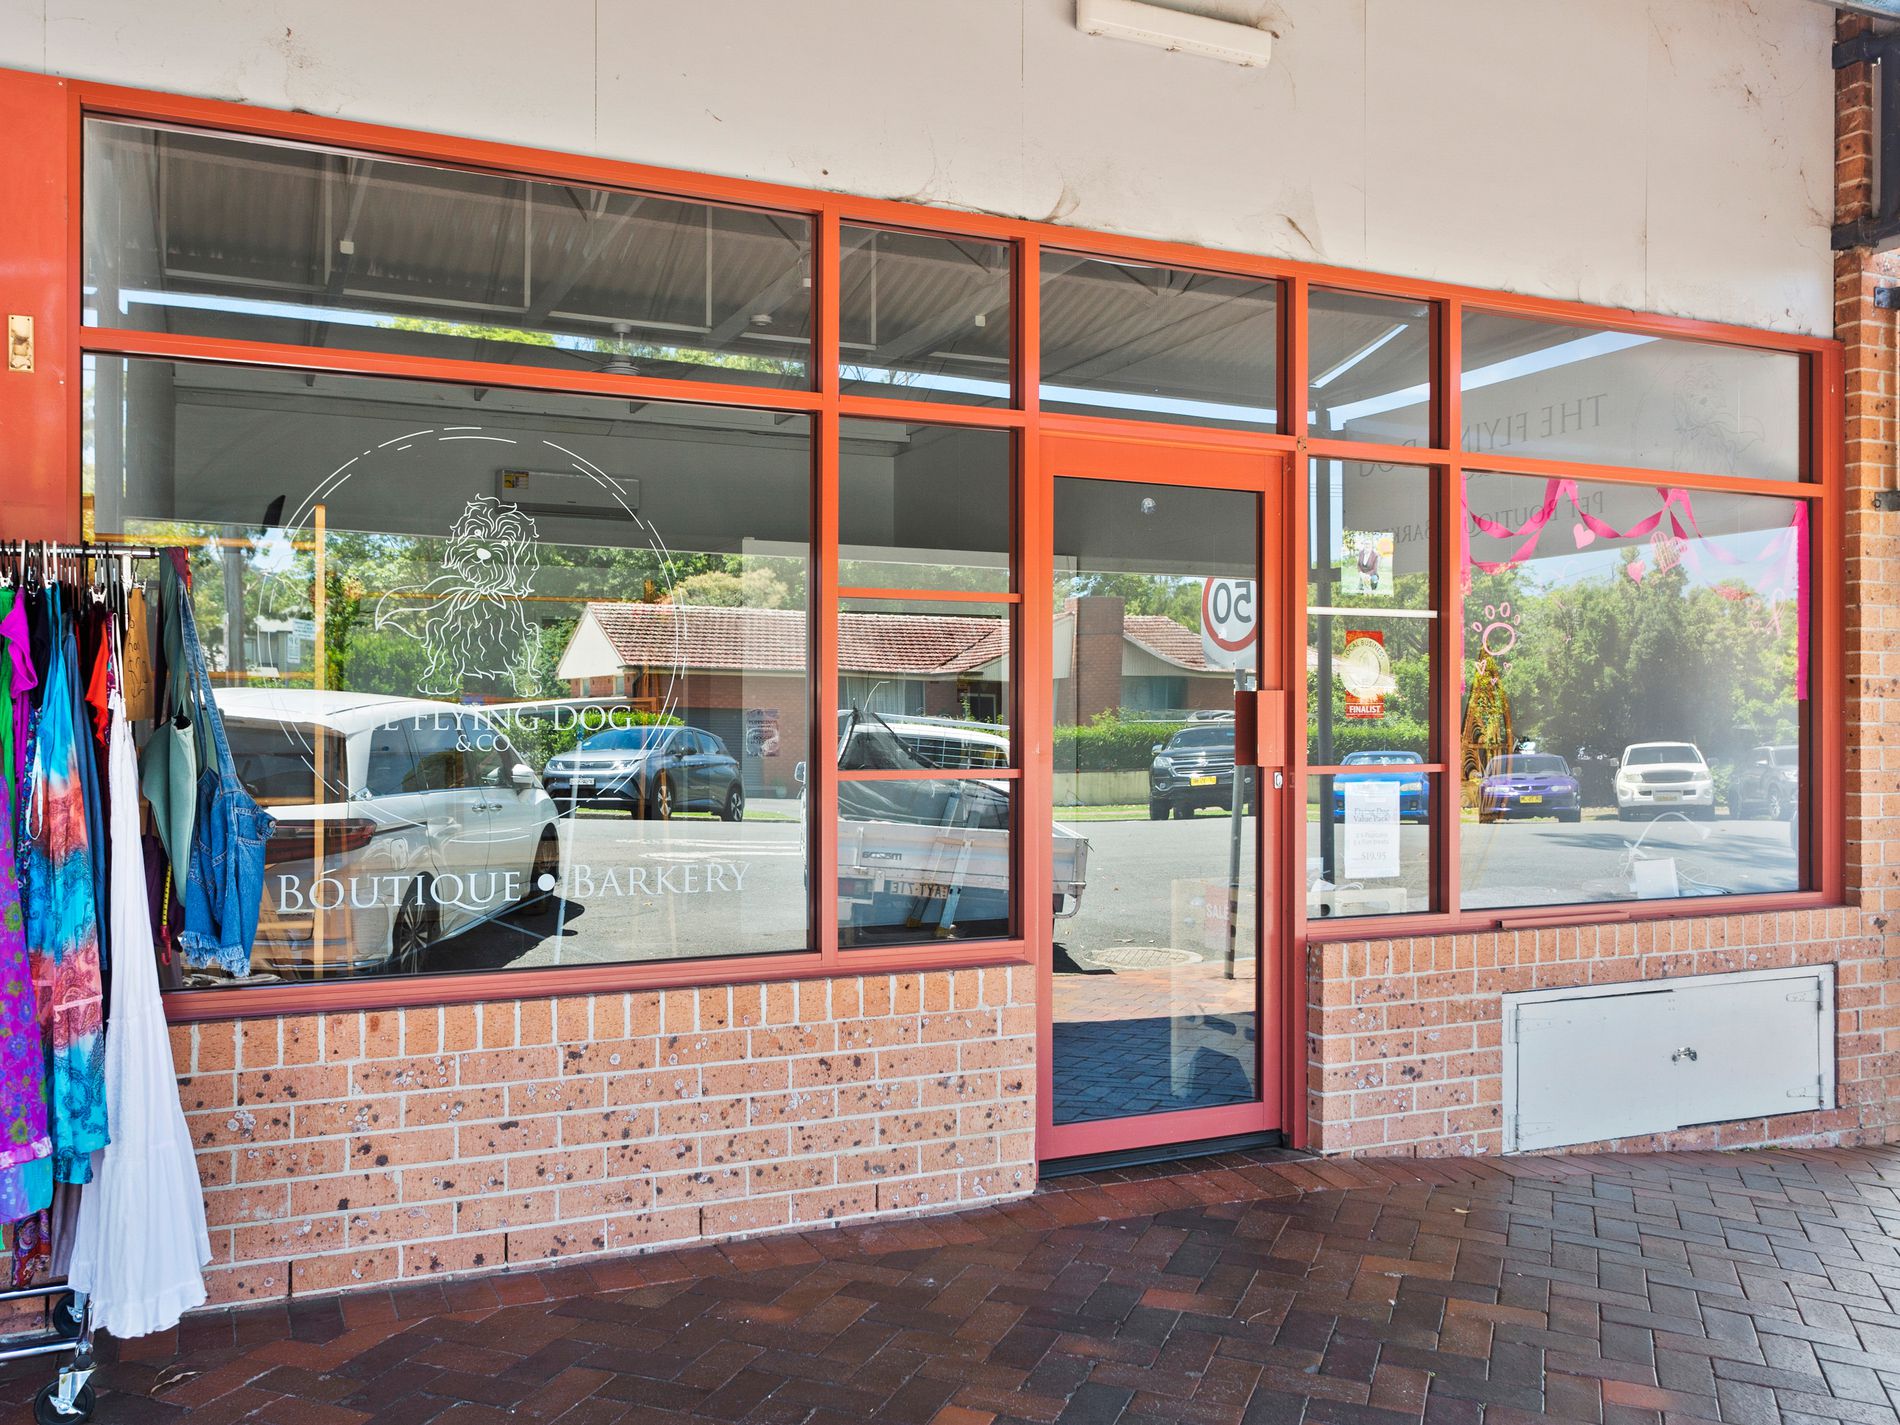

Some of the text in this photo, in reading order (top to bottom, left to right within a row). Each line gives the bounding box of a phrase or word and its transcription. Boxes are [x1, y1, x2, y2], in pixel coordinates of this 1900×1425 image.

[413, 705, 539, 731] FLYING
[553, 705, 632, 731] DOG
[1349, 705, 1381, 713] FINALIST
[572, 862, 752, 899] BARKERY
[1206, 903, 1229, 920] SALE
